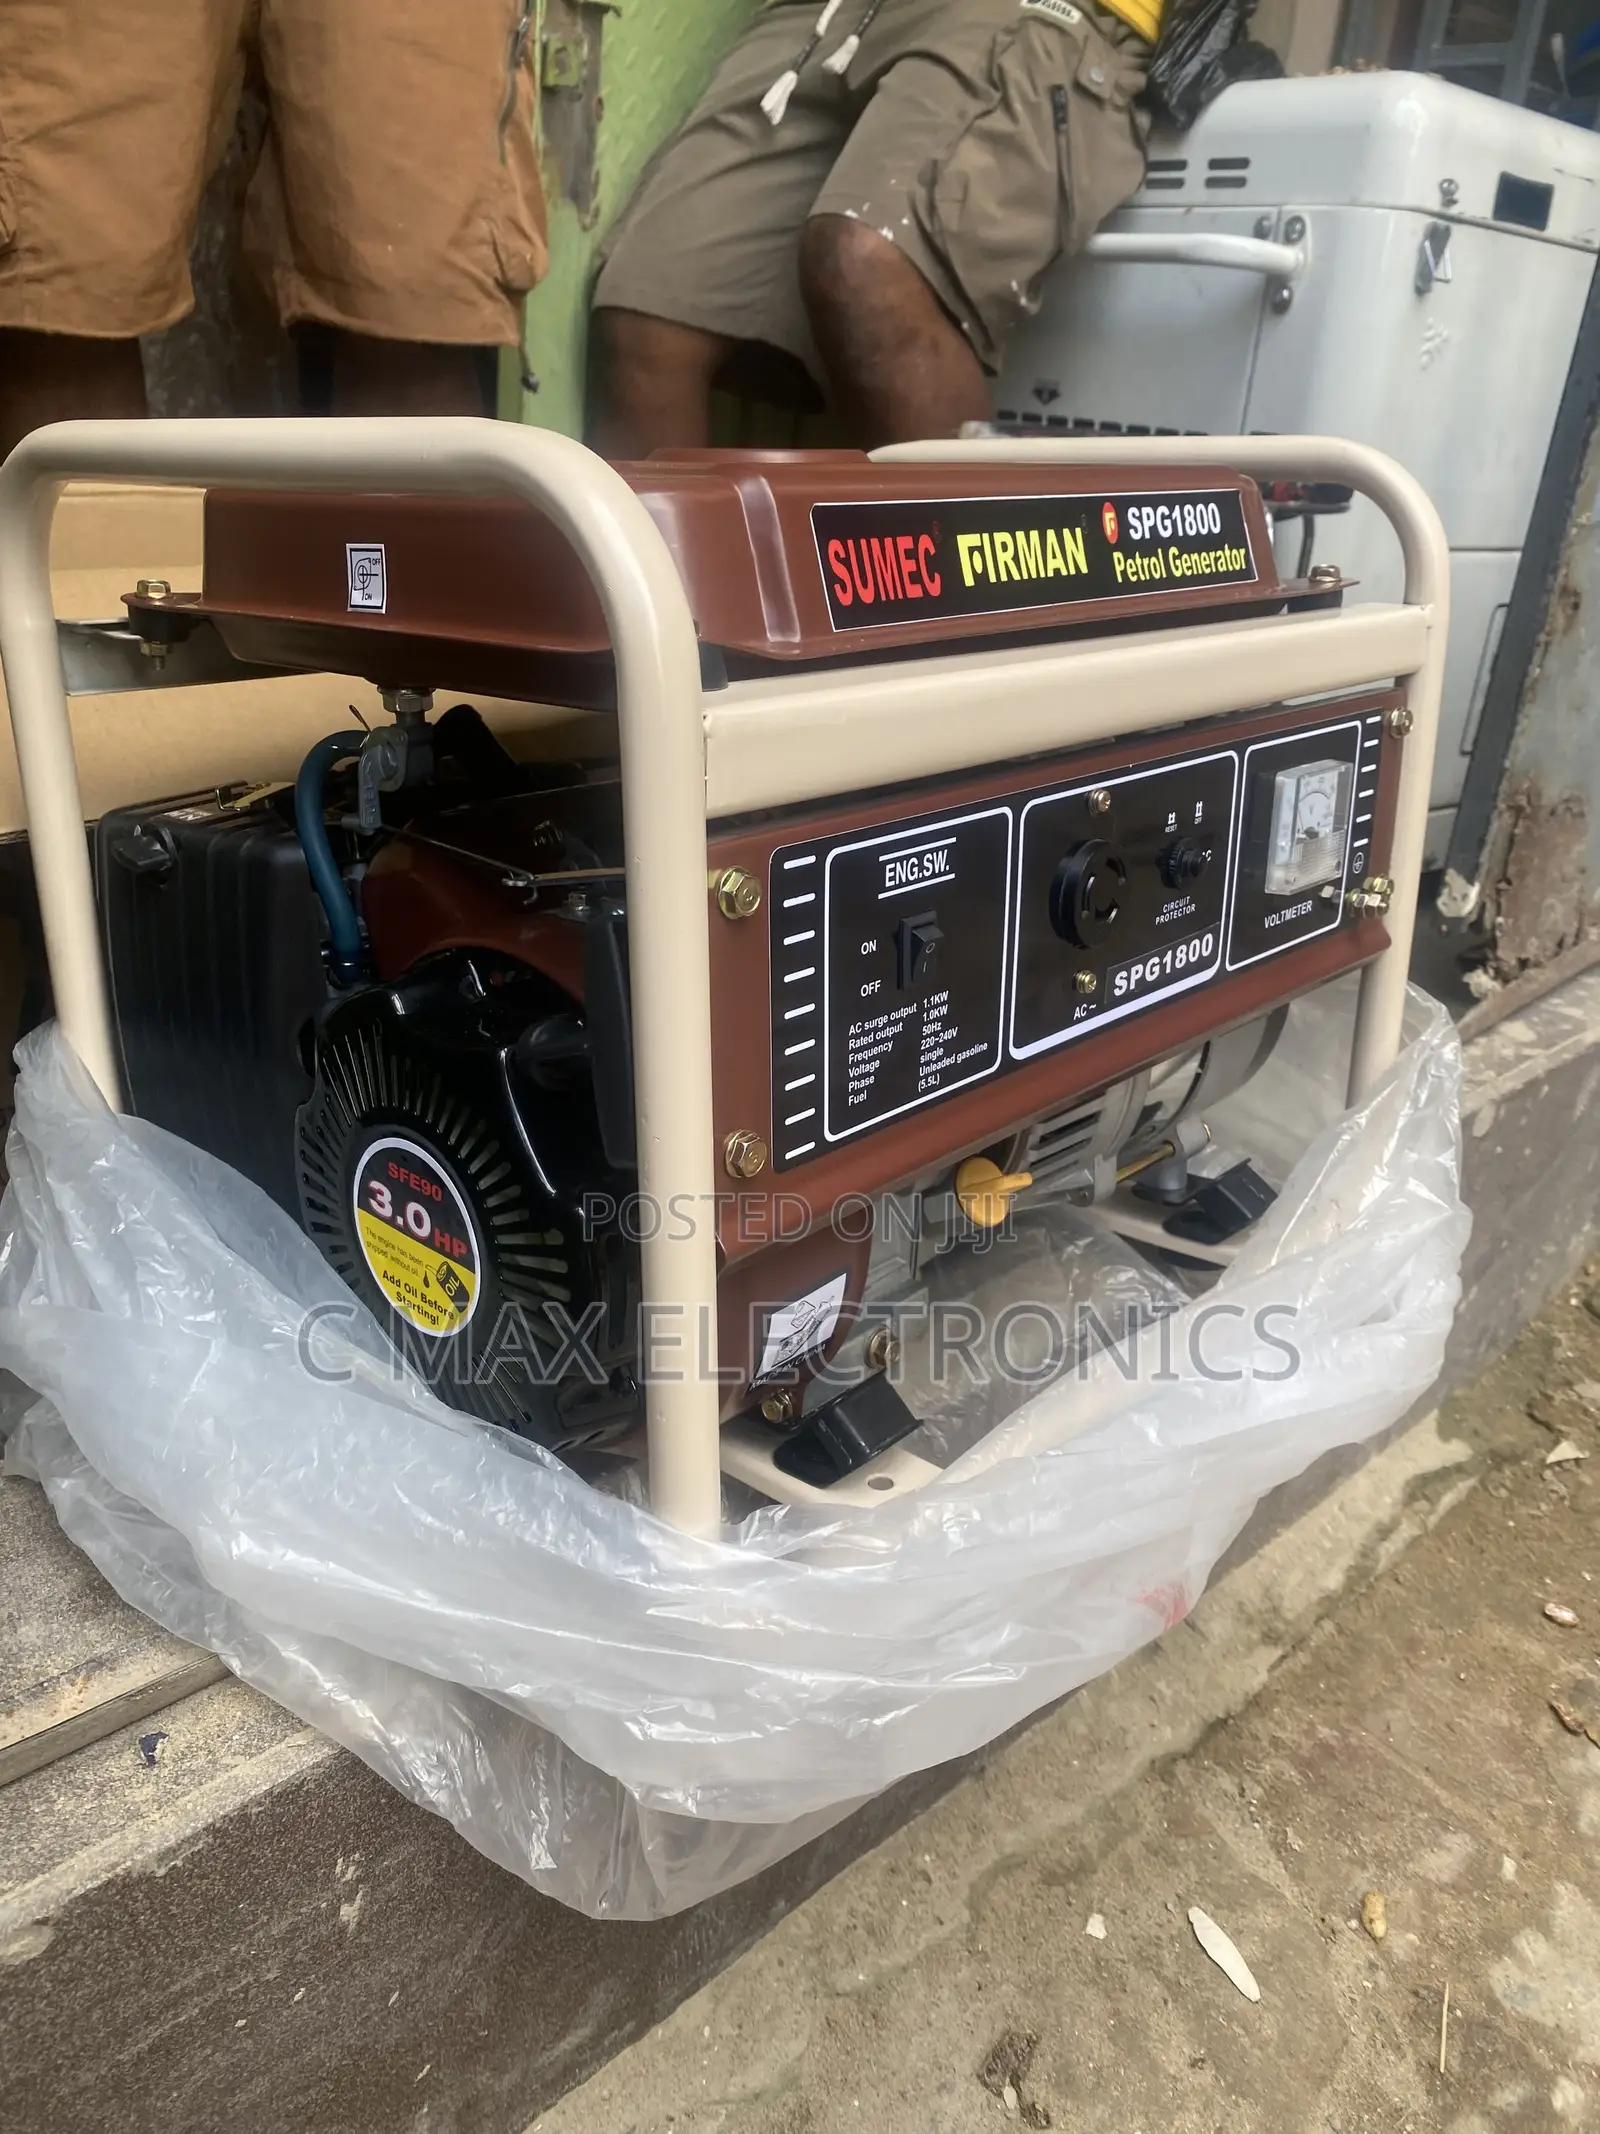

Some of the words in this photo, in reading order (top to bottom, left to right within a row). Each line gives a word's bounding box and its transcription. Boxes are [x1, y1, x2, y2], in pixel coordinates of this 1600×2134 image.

[1127, 502, 1222, 541] SPG1800
[828, 533, 941, 607] SUMEC
[956, 526, 1089, 587] FIRMAN
[1112, 548, 1166, 584] Petrol
[1168, 541, 1247, 578] Generator
[884, 849, 950, 888] ENG.SW.
[1155, 903, 1196, 926] PROTECTOR
[1162, 895, 1191, 913] CIRCUIT
[1264, 899, 1313, 929] VOLTMETER
[860, 939, 877, 956] ON
[1113, 932, 1214, 997] SPG1800
[860, 979, 882, 997] OFF
[848, 1021, 863, 1037] AC
[864, 1013, 889, 1031] surge
[889, 1002, 918, 1019] output
[923, 990, 949, 1009] 1.1KW
[848, 1032, 874, 1051] Rated
[875, 1021, 904, 1040] output
[922, 1003, 949, 1022] 1.0KW
[848, 1040, 894, 1065] Frequency
[922, 1021, 942, 1036] 50Hz
[848, 1059, 880, 1079] Voltage
[848, 1075, 875, 1093] Phase
[920, 1046, 944, 1064] single
[848, 1089, 867, 1107] Fuel
[919, 1053, 956, 1077] Unleaded
[956, 1042, 988, 1064] gasoline
[917, 1072, 940, 1093] (5.5L)
[387, 1162, 443, 1202] SFE90
[367, 1179, 432, 1240] 3.0
[433, 1226, 468, 1258] HP
[365, 1226, 377, 1240] The
[377, 1235, 396, 1251] engine
[408, 1252, 424, 1267] been
[382, 1269, 401, 1289] Add
[404, 1282, 418, 1299] Oil
[420, 1292, 454, 1320] Before
[445, 1276, 460, 1296] OIL
[395, 1291, 440, 1326] Starting!
